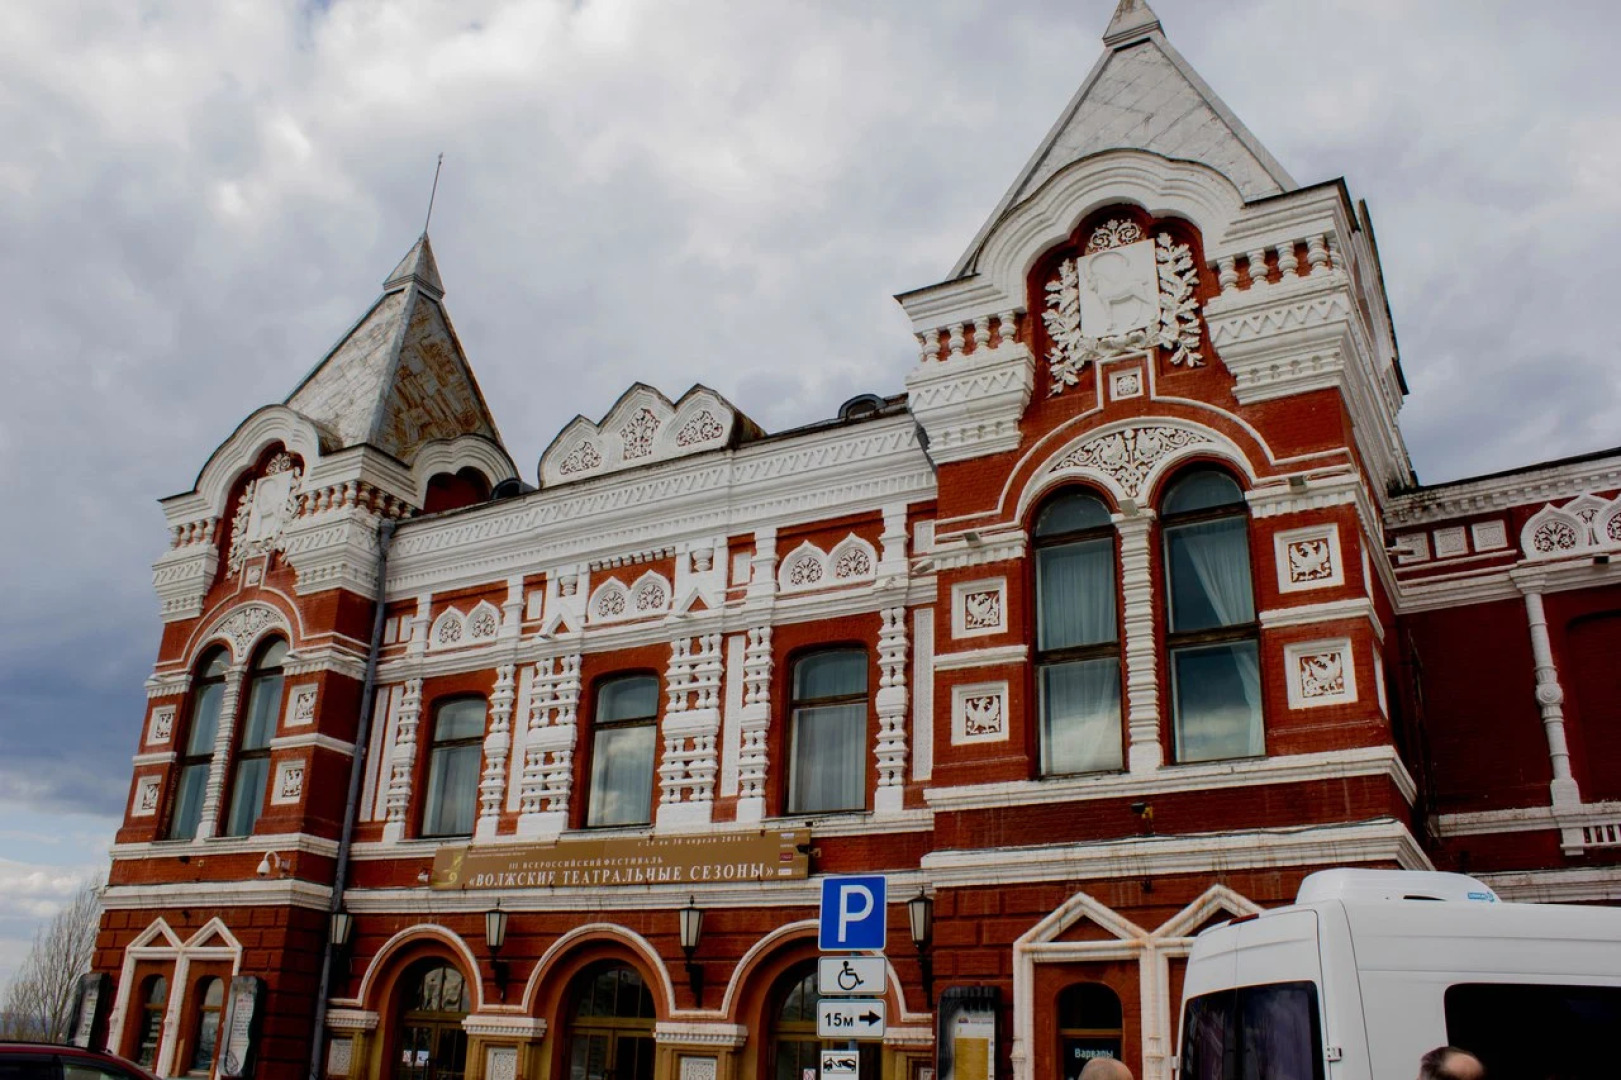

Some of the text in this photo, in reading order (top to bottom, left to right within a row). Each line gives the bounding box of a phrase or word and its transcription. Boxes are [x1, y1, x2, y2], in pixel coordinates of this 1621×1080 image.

[522, 858, 602, 869] ВСЕРОССИЙСКИЙ
[603, 857, 664, 867] ФЕСТИВАЛЬ
[469, 862, 774, 887] «ВОЛЖСКИЕ ТЕАТРАЛЬНЫЕ СЕЗОНЫ»
[837, 884, 875, 943] P
[824, 1012, 854, 1028] 15м
